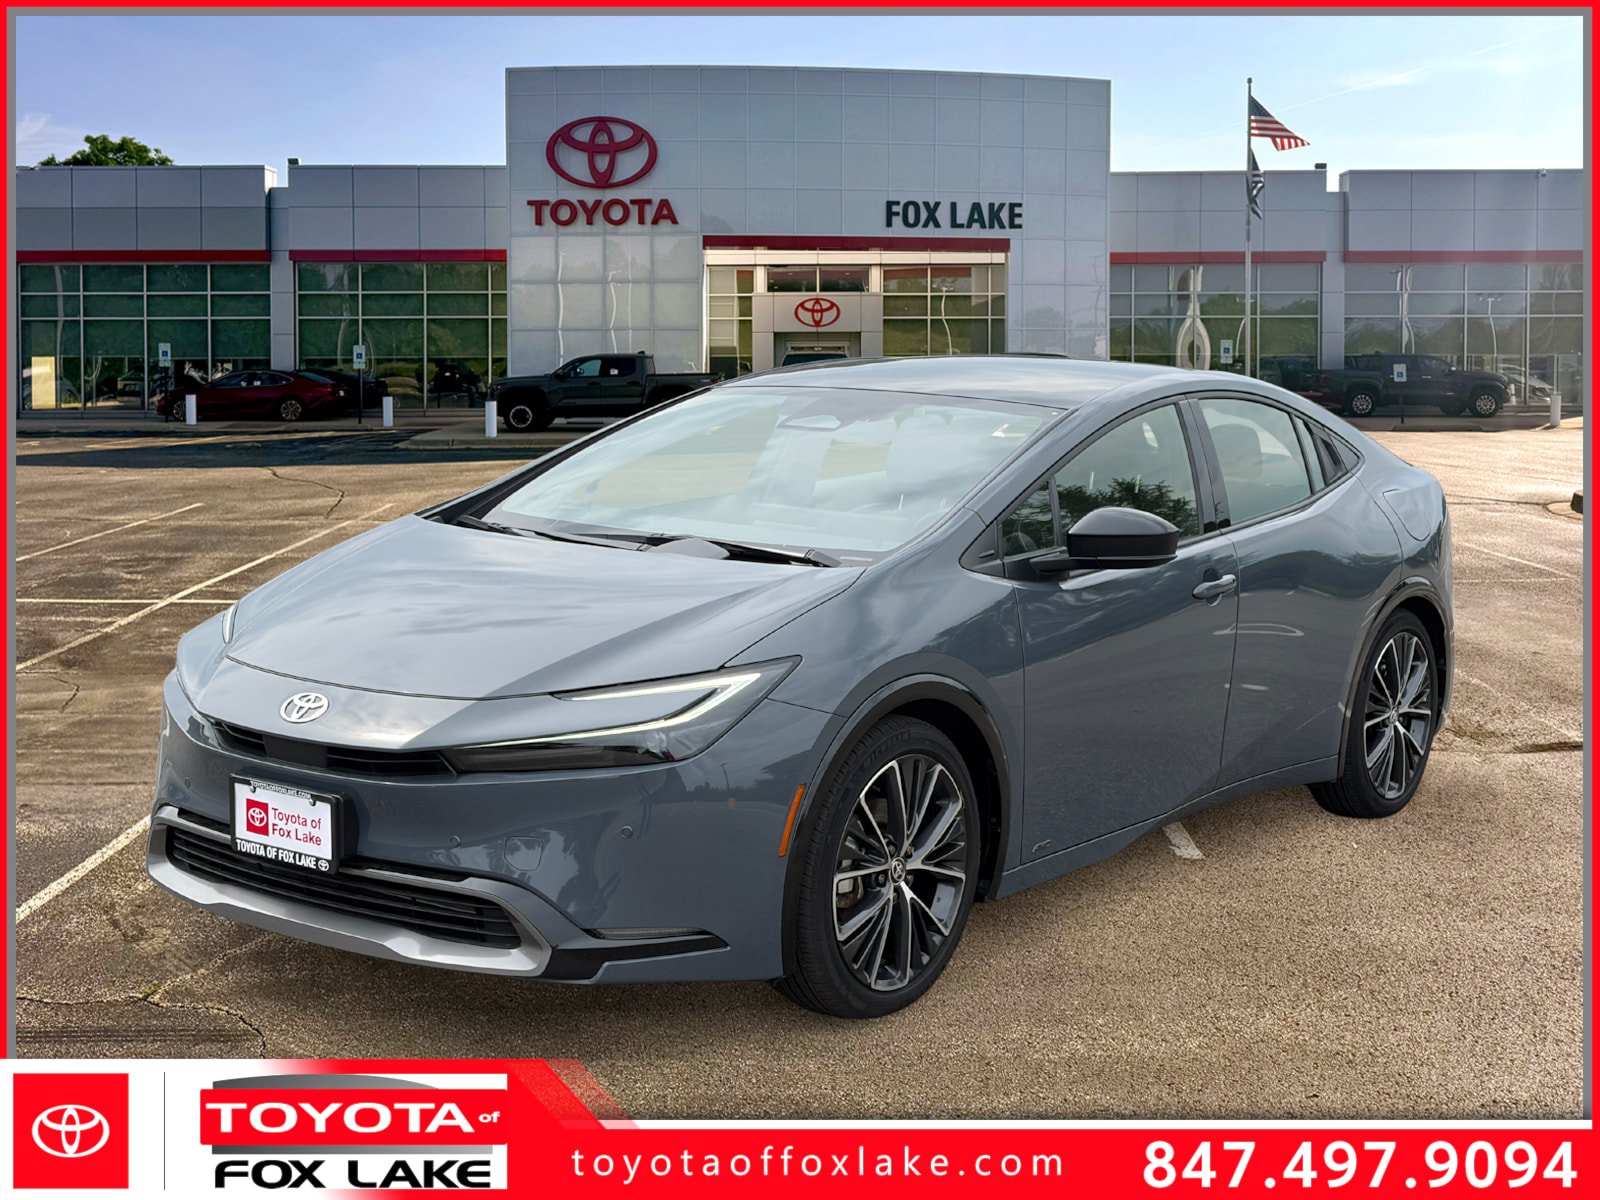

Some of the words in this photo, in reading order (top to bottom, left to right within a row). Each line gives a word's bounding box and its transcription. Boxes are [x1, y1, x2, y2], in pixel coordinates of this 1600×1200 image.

[526, 198, 679, 226] TOYOTA
[885, 200, 942, 228] FOX
[950, 201, 1023, 229] LAKE
[271, 807, 307, 826] Toyota
[310, 818, 322, 830] of
[271, 823, 291, 839] Fox
[295, 829, 322, 846] Lake
[236, 839, 265, 856] TOYOTA
[266, 846, 277, 859] OF
[279, 850, 294, 864] FOX
[296, 853, 317, 869] LAKE
